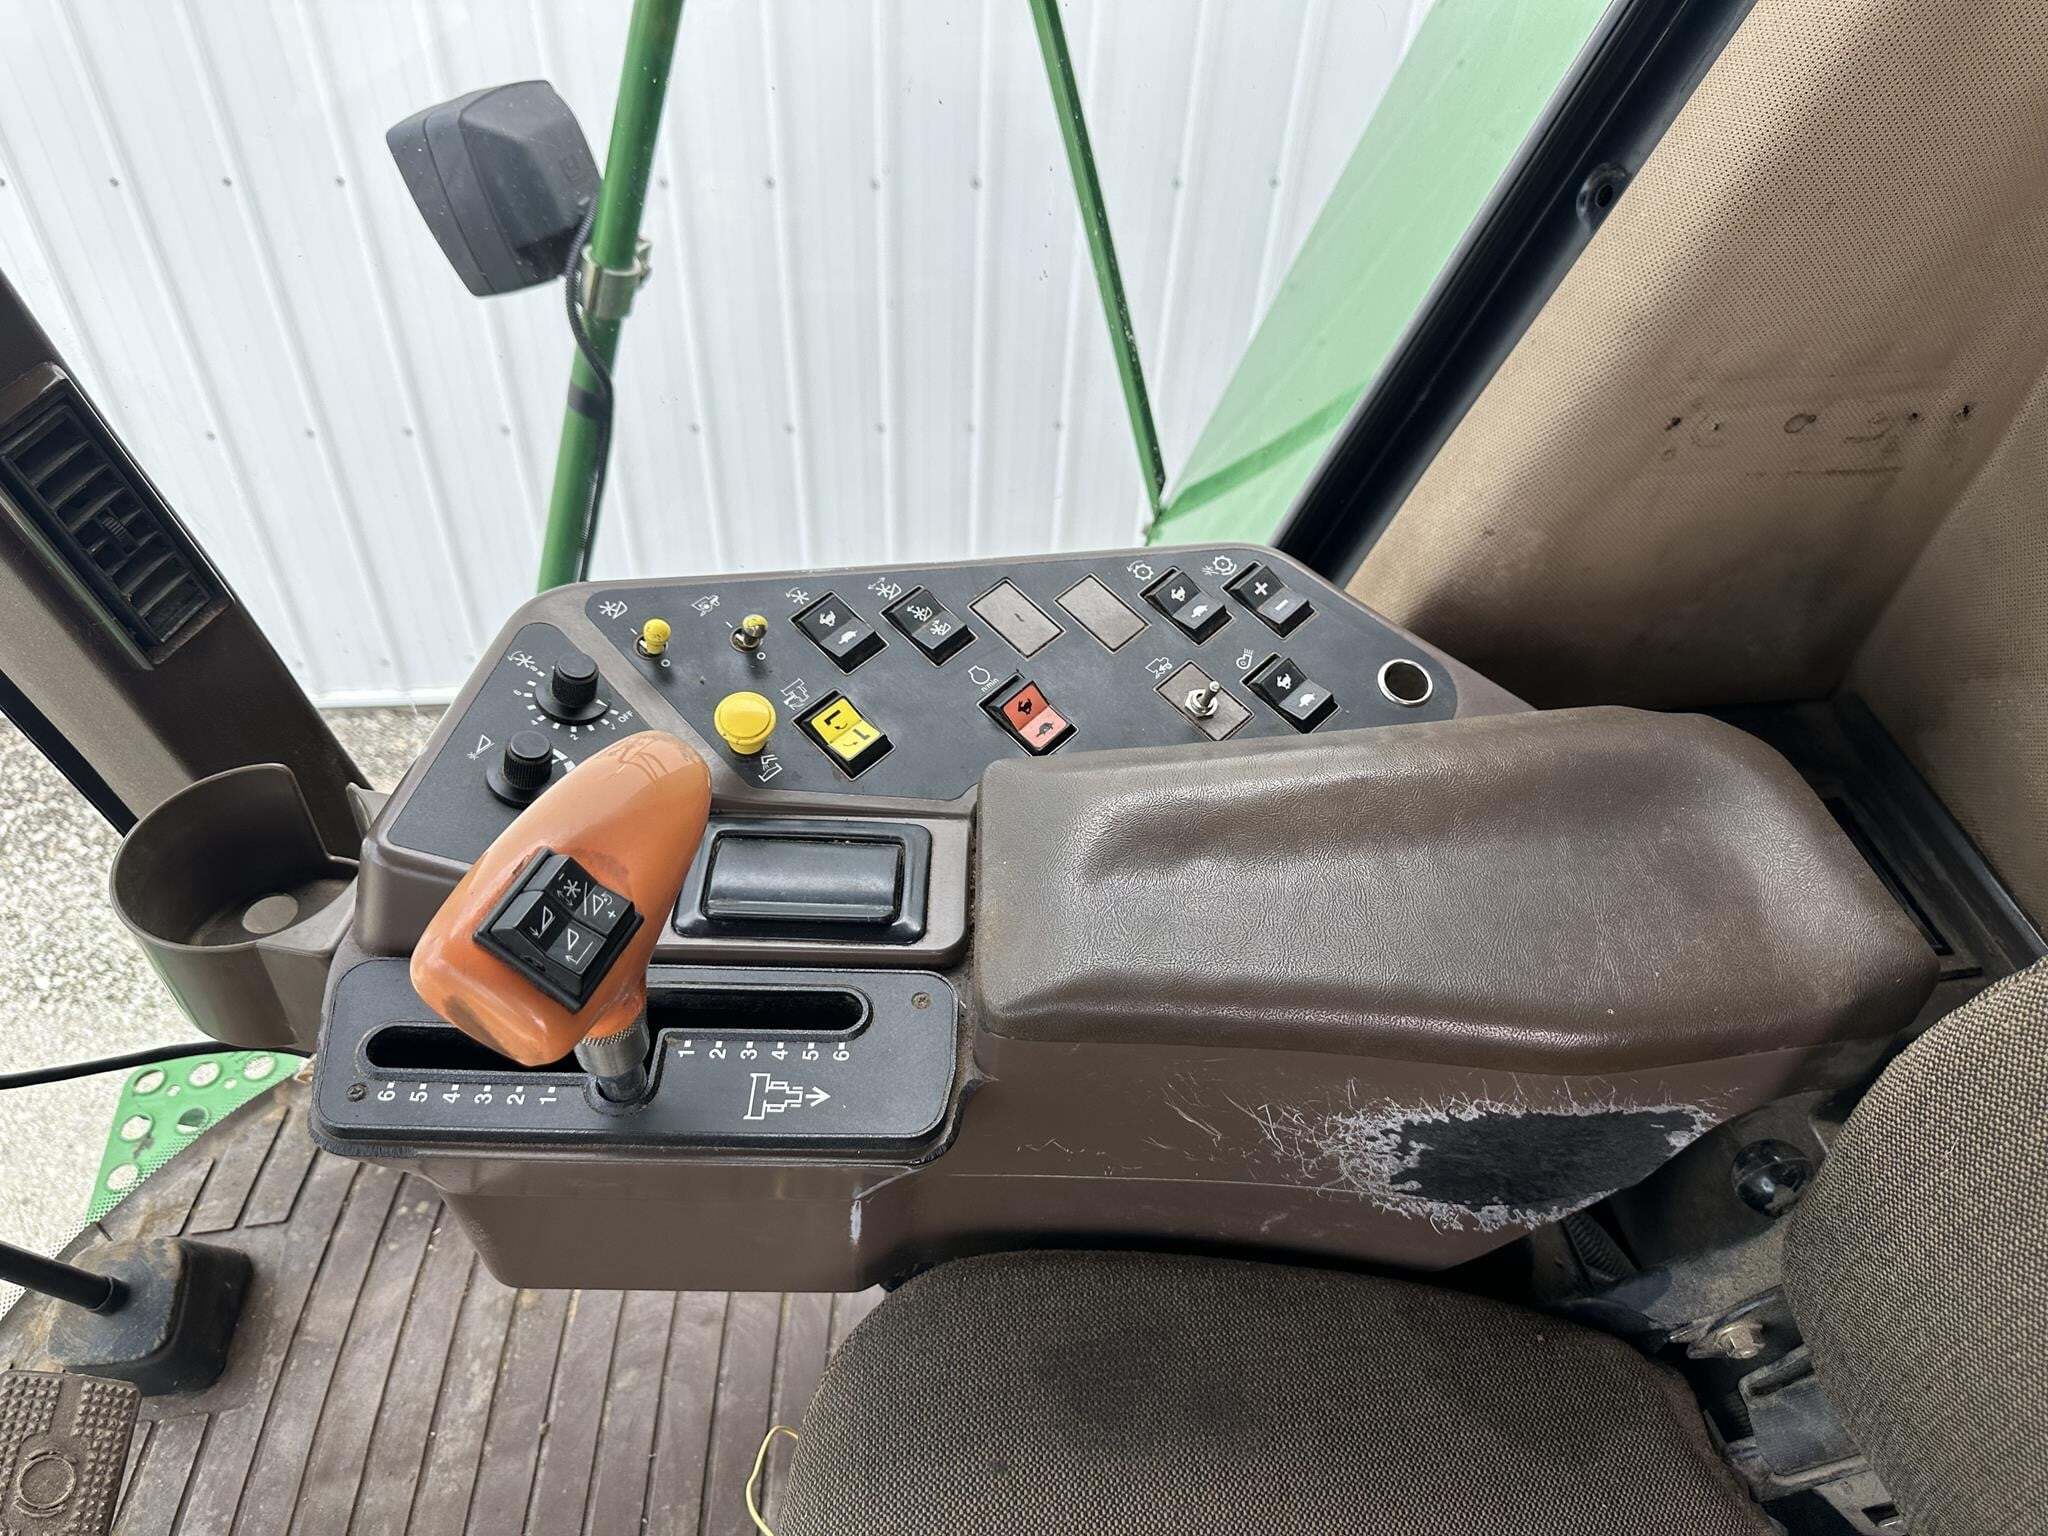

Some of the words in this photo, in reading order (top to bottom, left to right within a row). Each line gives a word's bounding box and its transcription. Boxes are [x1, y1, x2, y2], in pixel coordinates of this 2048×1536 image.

[617, 710, 634, 723] OFF
[678, 1050, 695, 1058] 1
[709, 1048, 727, 1059] 2
[740, 1048, 758, 1060] 3
[771, 1048, 789, 1061] 4
[802, 1049, 819, 1061] 5
[832, 1050, 850, 1061] 6
[377, 1090, 396, 1102] 6
[408, 1091, 428, 1102] 5
[442, 1090, 460, 1103] 4
[474, 1092, 493, 1104] 3
[506, 1093, 526, 1105] 2
[539, 1097, 557, 1105] 1
